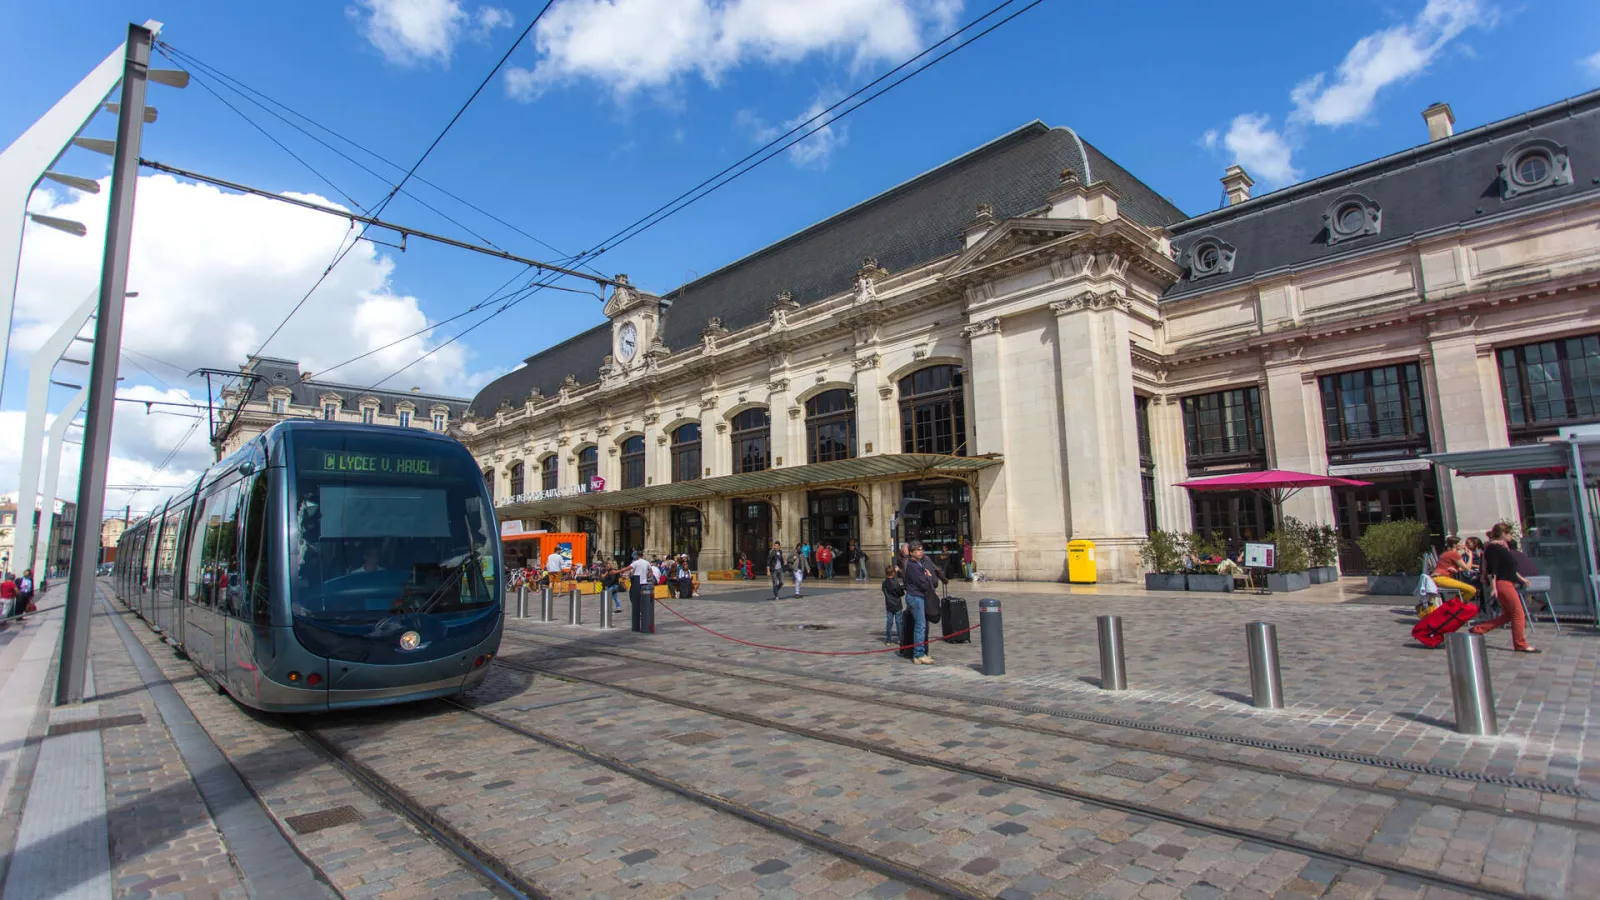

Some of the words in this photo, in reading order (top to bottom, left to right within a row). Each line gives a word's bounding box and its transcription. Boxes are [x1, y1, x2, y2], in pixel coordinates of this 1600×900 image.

[339, 456, 376, 471] LYCEE
[397, 459, 432, 474] HAVEL
[591, 480, 603, 490] SNCF
